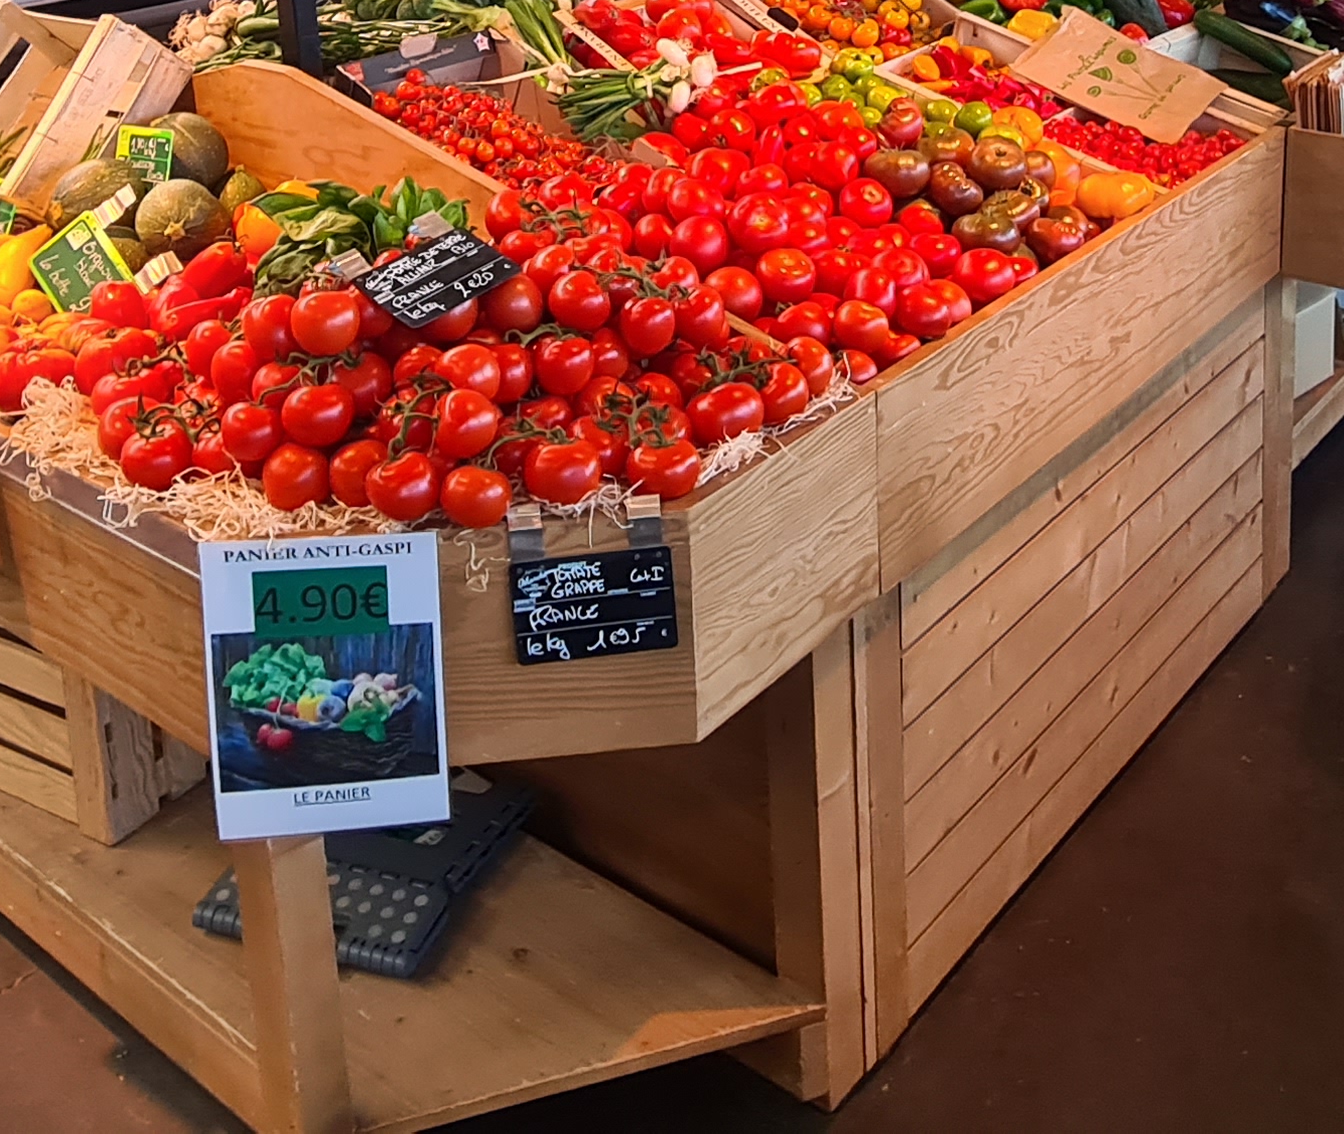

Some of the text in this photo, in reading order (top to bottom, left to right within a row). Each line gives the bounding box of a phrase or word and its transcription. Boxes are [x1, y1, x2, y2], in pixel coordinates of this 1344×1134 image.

[450, 242, 475, 254] BIO
[223, 542, 413, 563] PANIER ANTI-GASPI
[544, 562, 601, 584] TOMATE
[551, 579, 605, 598] GRAPPE
[256, 581, 388, 624] 4.90€
[529, 604, 599, 632] FRANCE
[294, 787, 371, 805] LE PANIER
